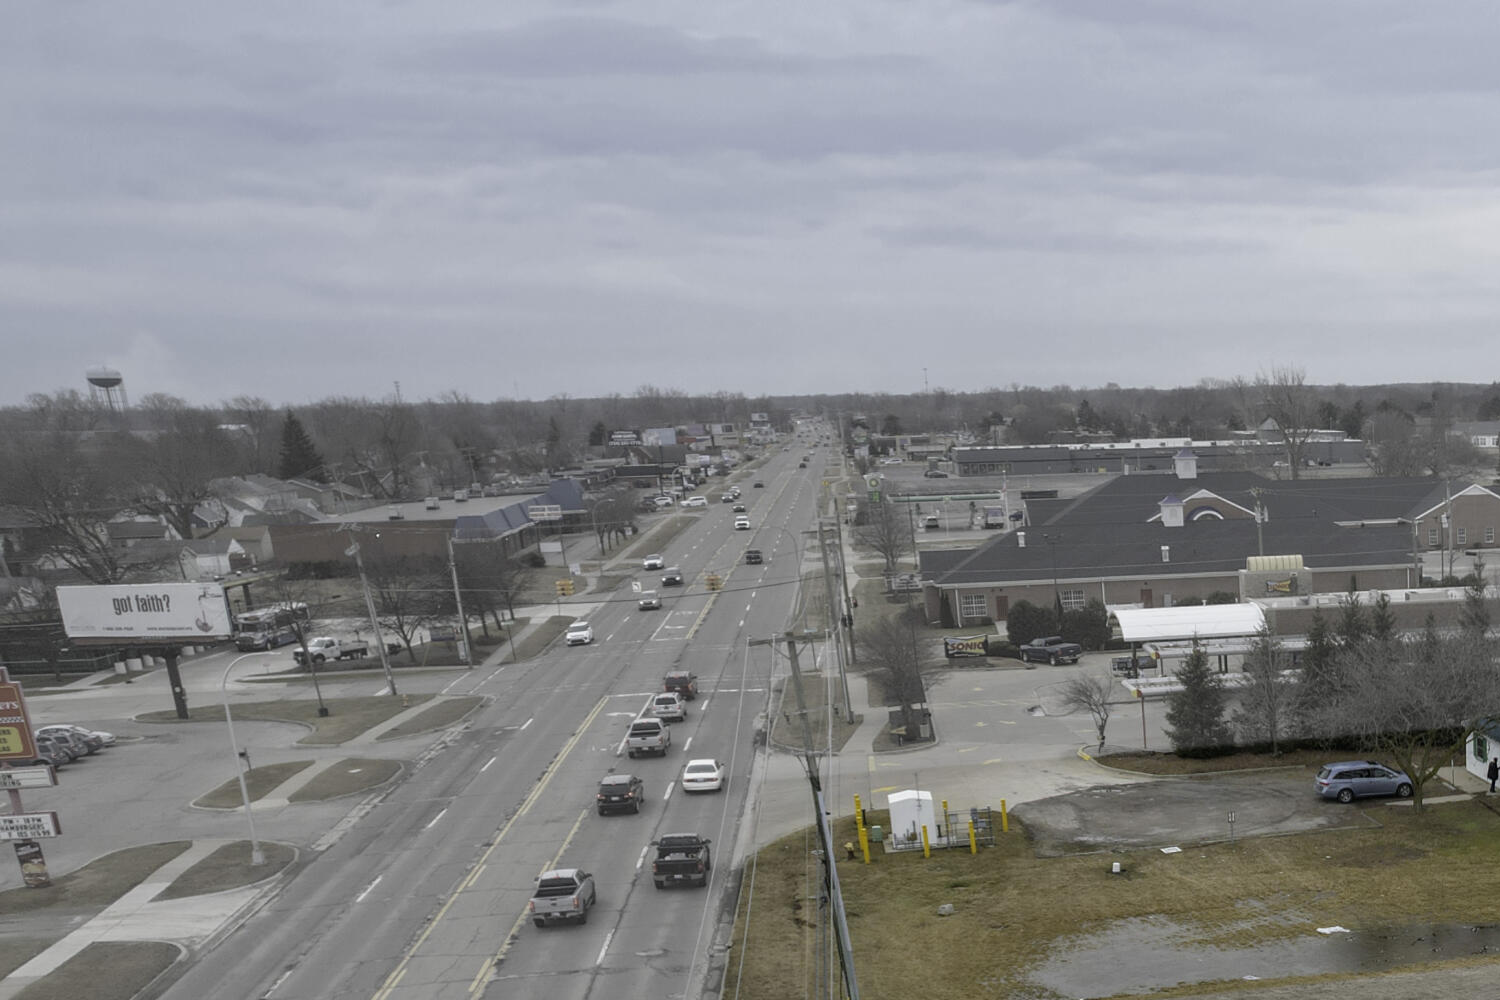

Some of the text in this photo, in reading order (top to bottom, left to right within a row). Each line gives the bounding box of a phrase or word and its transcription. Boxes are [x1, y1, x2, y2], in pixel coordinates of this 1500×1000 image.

[112, 594, 171, 616] got faith?
[950, 641, 985, 651] SONIC
